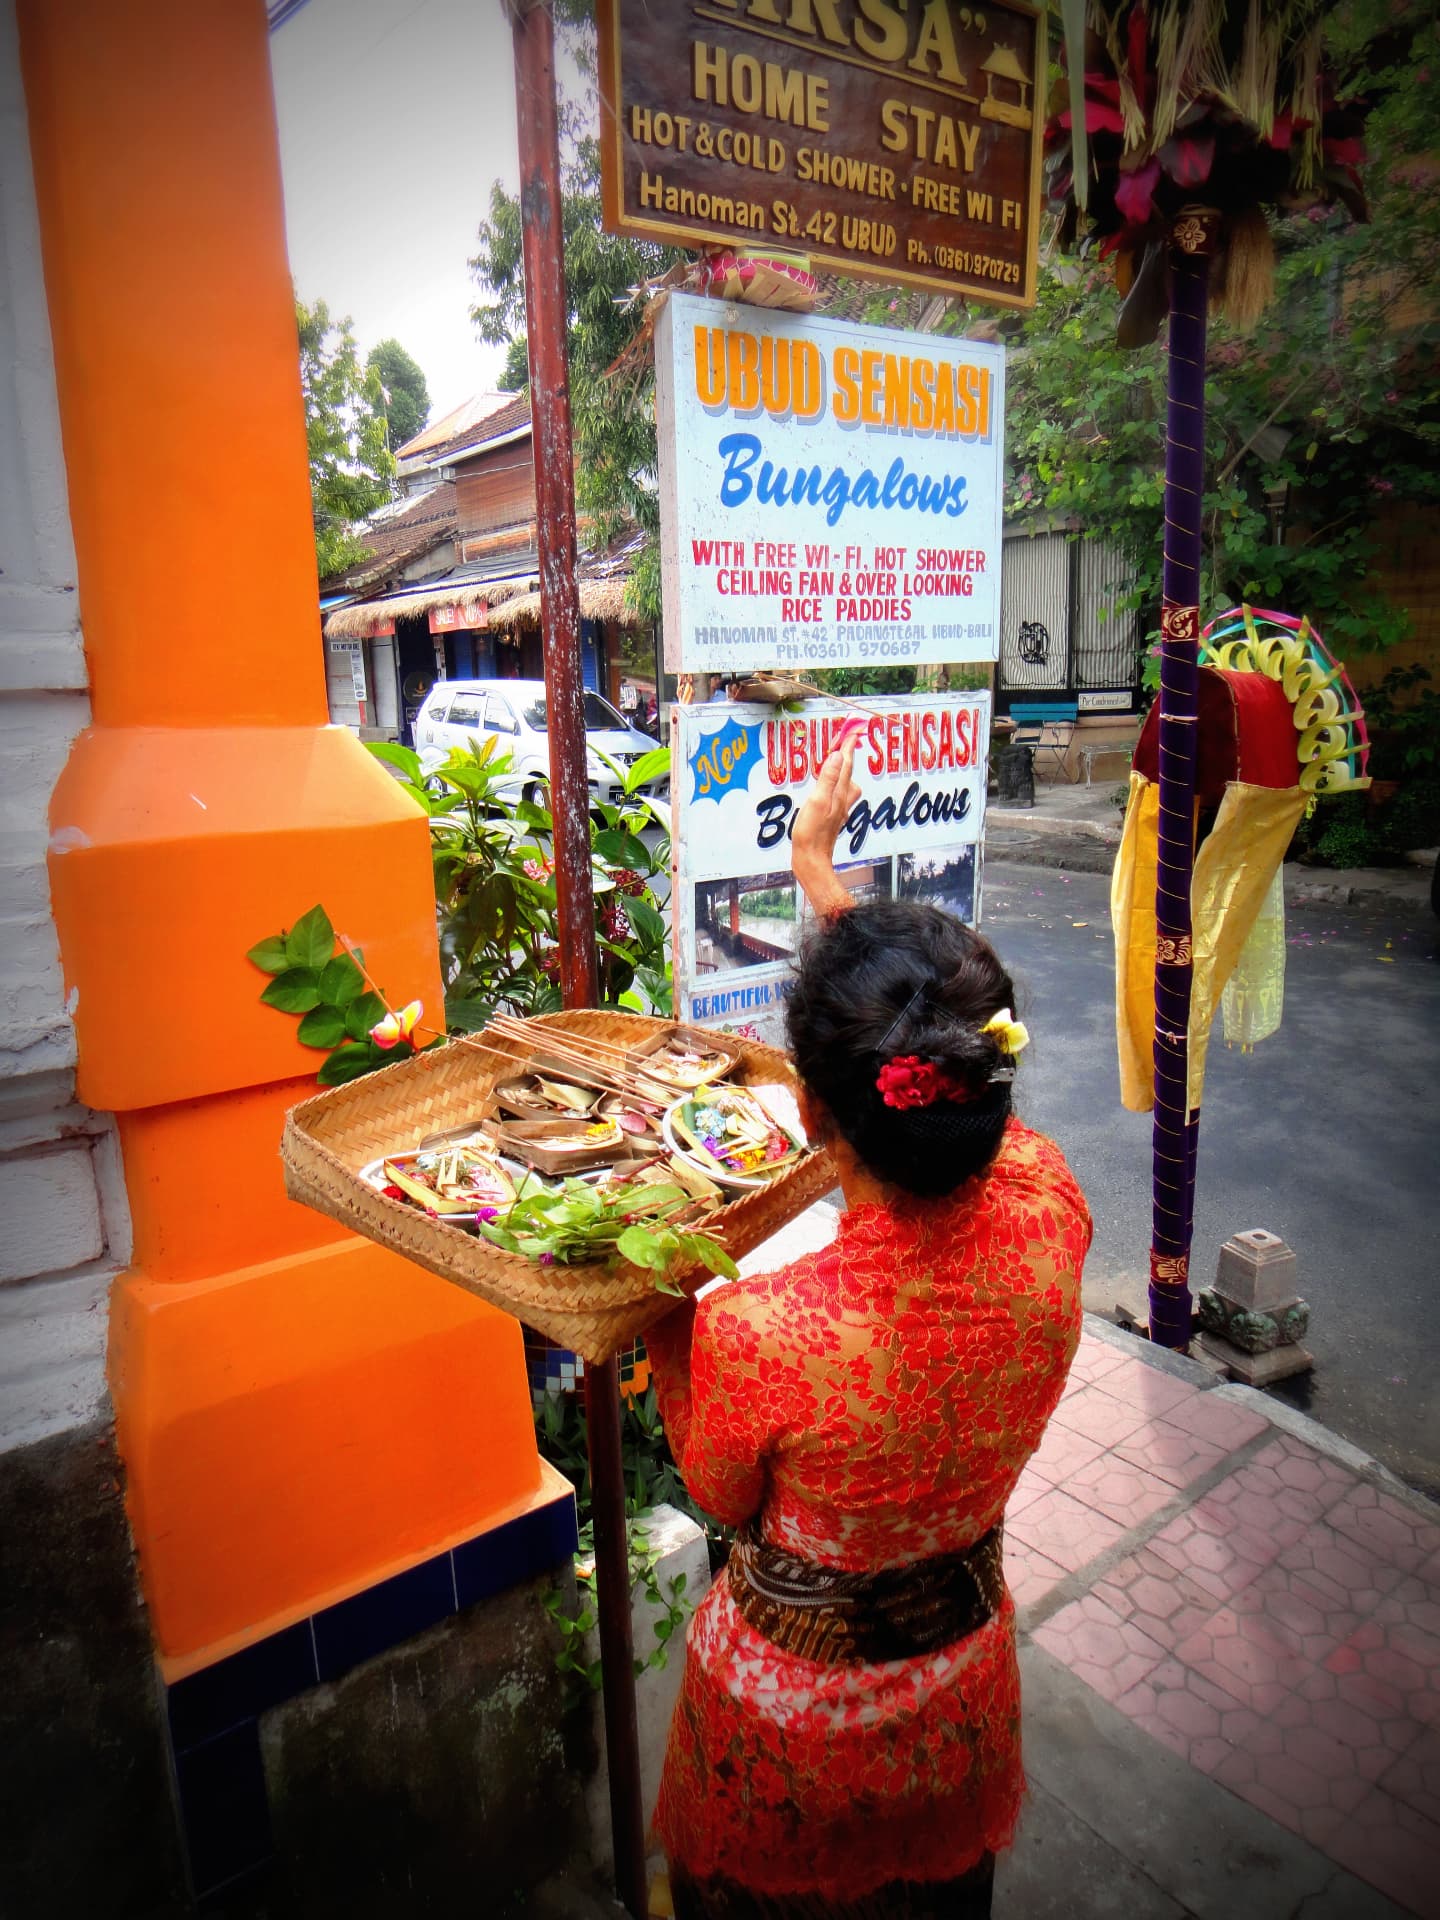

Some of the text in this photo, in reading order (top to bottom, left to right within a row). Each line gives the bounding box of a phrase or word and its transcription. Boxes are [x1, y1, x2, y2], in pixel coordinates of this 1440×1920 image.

[693, 40, 982, 173] HOME STAY
[640, 172, 765, 230] Hanoman
[842, 215, 897, 257] UBUD
[797, 147, 895, 200] SHOWER
[912, 177, 960, 215] FREE
[967, 189, 993, 224] WI
[1002, 200, 1021, 230] FI
[694, 326, 993, 442] UBUD SENSASI
[718, 432, 968, 527] Bungalows
[692, 540, 745, 567] WITH
[754, 543, 797, 568] FREE
[874, 547, 907, 571] HOT
[915, 549, 986, 573] SHOWER
[717, 569, 792, 596] CEILING
[800, 570, 834, 595] FAN
[903, 575, 973, 597] LOOKING
[695, 626, 777, 645] HANOMAN
[837, 624, 927, 641] PADANGTEGAL
[782, 599, 912, 622] RICE PADDIES
[859, 641, 921, 657] 970687
[698, 729, 749, 794] New
[867, 708, 980, 775] SENSASI
[756, 781, 971, 855] Bgalows
[692, 984, 772, 1020] BEAUTIFUL
